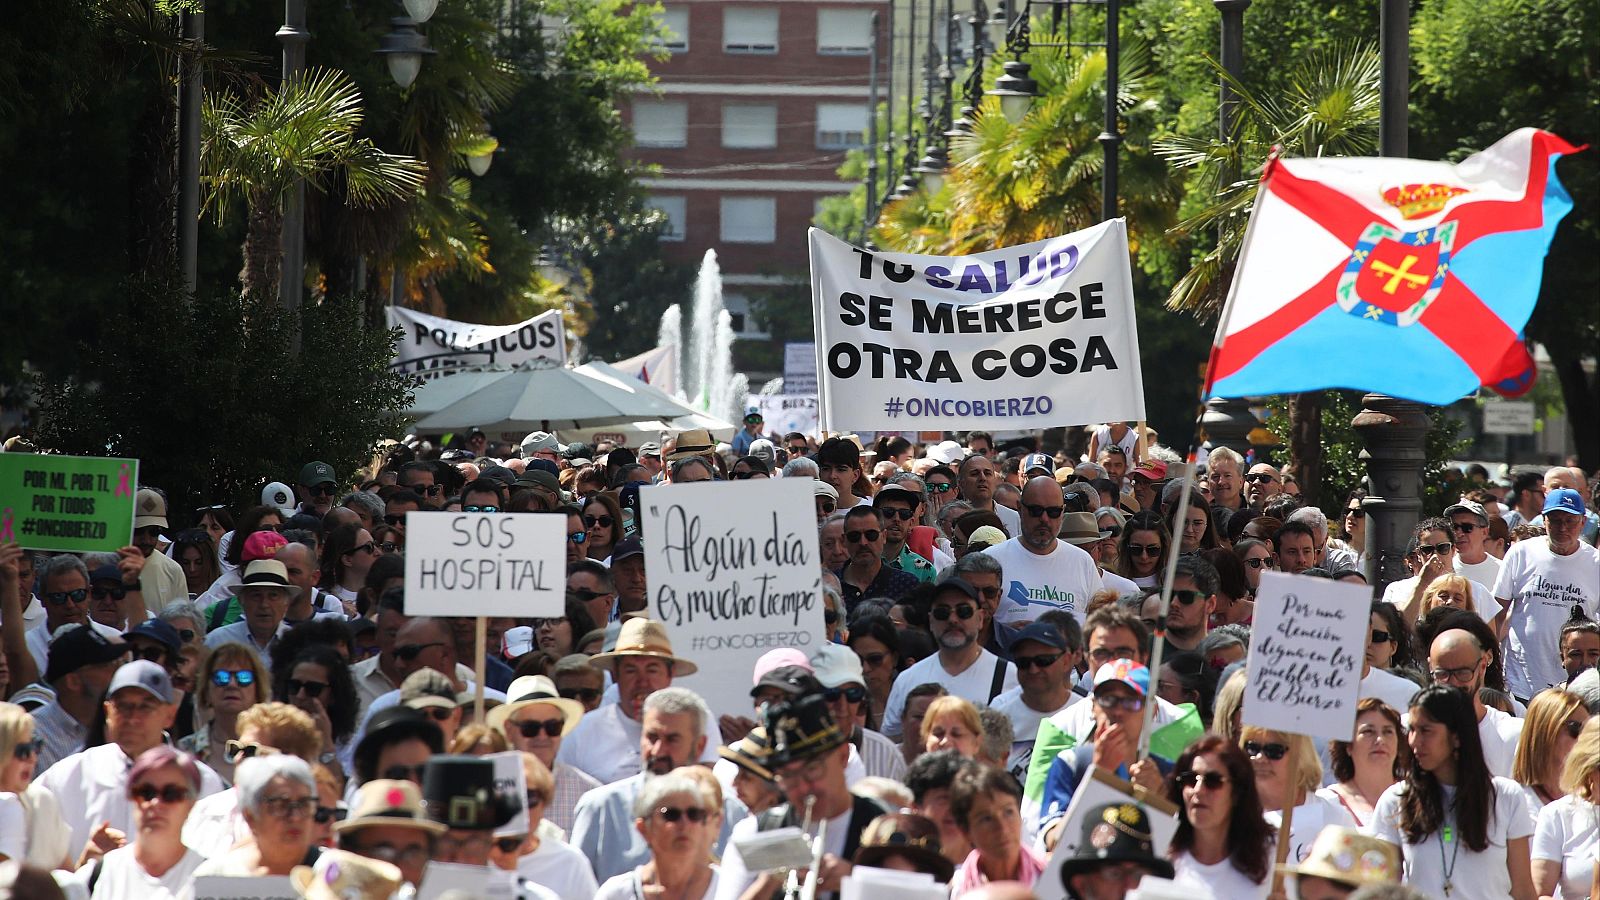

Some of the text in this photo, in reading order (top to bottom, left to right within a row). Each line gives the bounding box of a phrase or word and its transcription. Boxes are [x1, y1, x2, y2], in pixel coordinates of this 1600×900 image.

[923, 244, 1080, 294] SALUD
[839, 282, 1107, 334] SE MERECE
[827, 335, 1119, 383] OTRA COSA
[884, 395, 1053, 419] #ONCOBIERZO
[24, 470, 46, 488] POR
[71, 473, 93, 491] POR
[32, 495, 95, 514] POR TODOS
[21, 518, 107, 539] #ONCOBIERZO
[451, 516, 515, 549] SOS
[763, 511, 809, 567] día
[656, 584, 682, 627] es
[687, 580, 756, 623] mucho
[1282, 592, 1346, 620] Por una
[692, 630, 812, 651] #ONCOBIERZO
[1257, 636, 1355, 671] digna en los
[1255, 662, 1347, 688] pueblos de
[1256, 679, 1343, 710] El Bierzo
